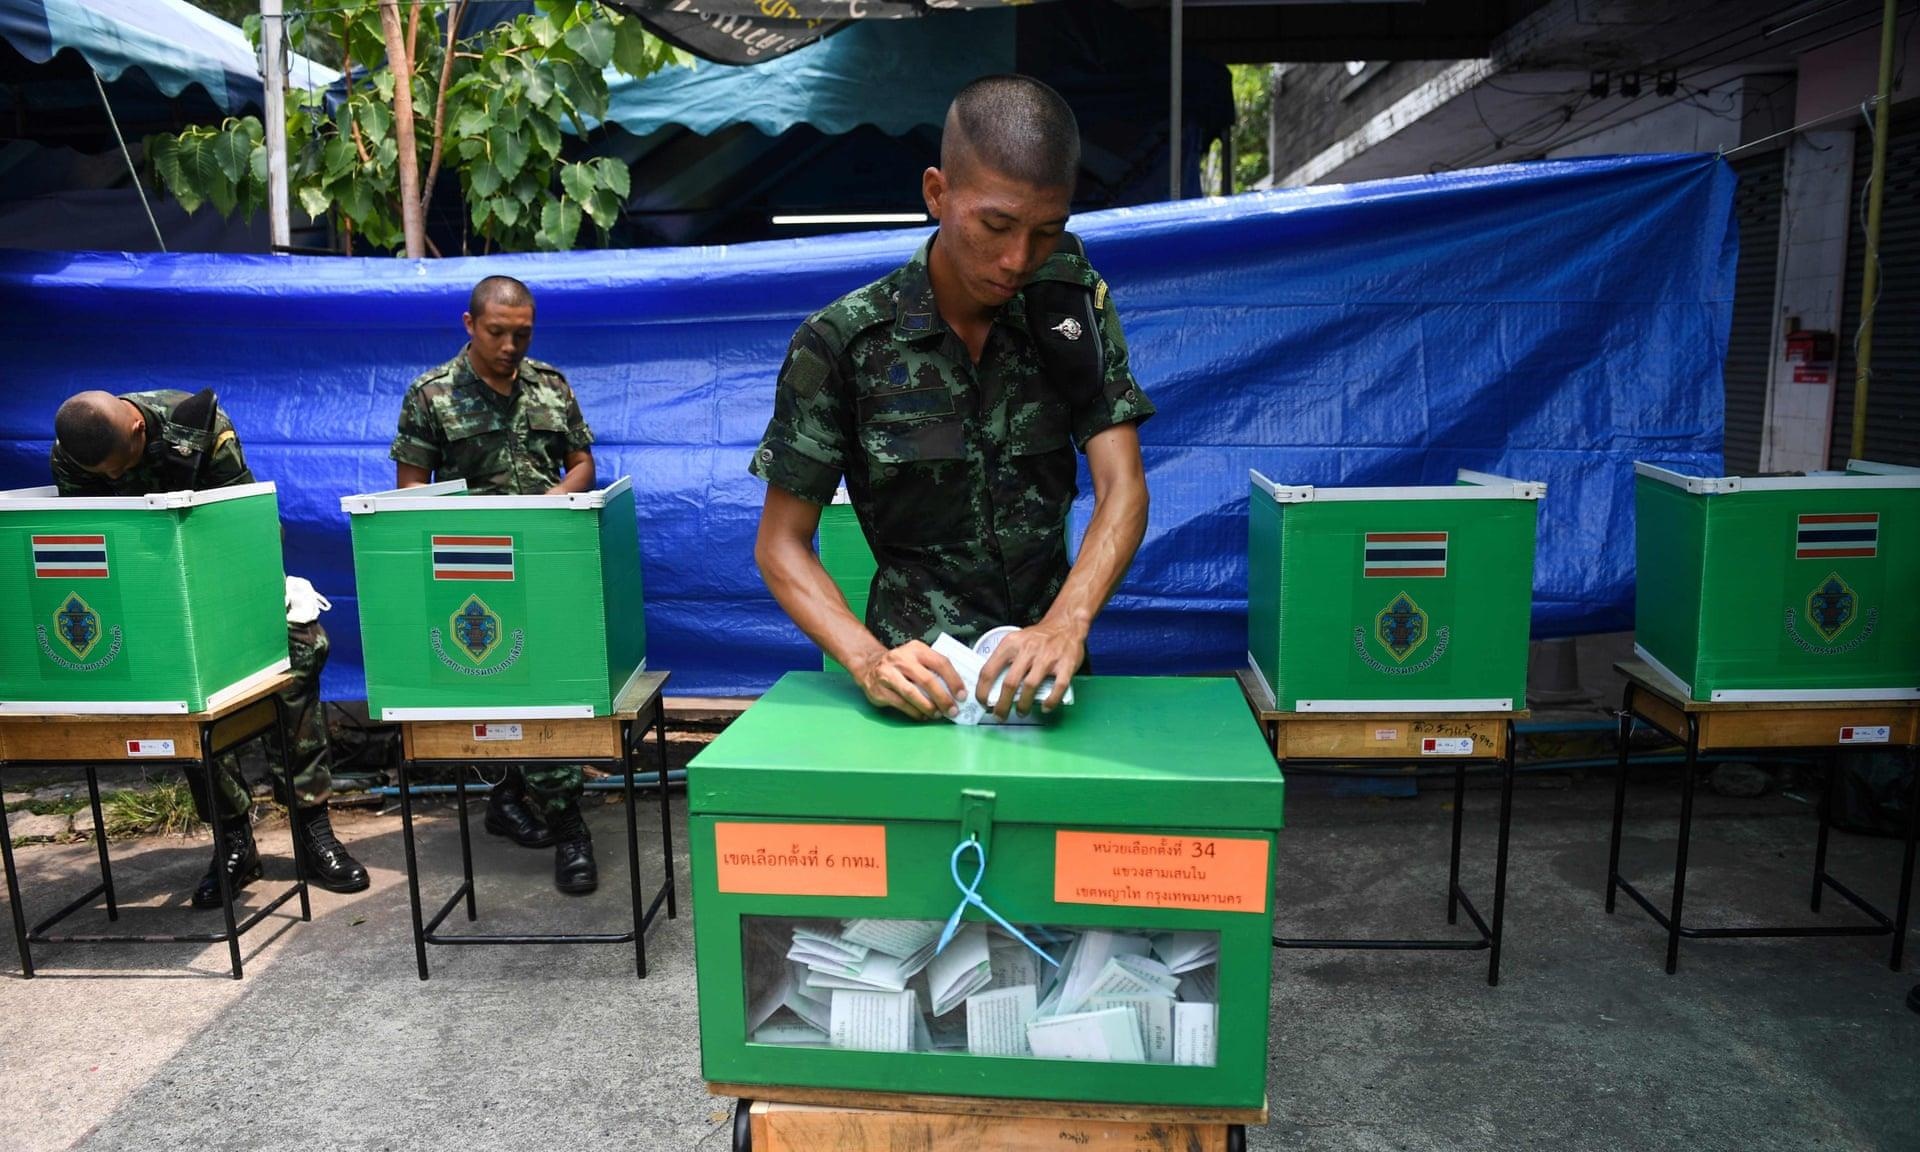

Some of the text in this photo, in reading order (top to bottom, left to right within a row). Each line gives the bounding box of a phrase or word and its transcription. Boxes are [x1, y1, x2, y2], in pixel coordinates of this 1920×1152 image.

[723, 843, 880, 869] เขตเลือกตั้งที่ 6 กทม.
[1093, 838, 1217, 859] หน่วยเลือกตั้งที่ 34
[1112, 865, 1207, 881] แขวงสามเสนใน
[1076, 885, 1243, 905] เขตพญาไท กรุงเทพมหานคร
